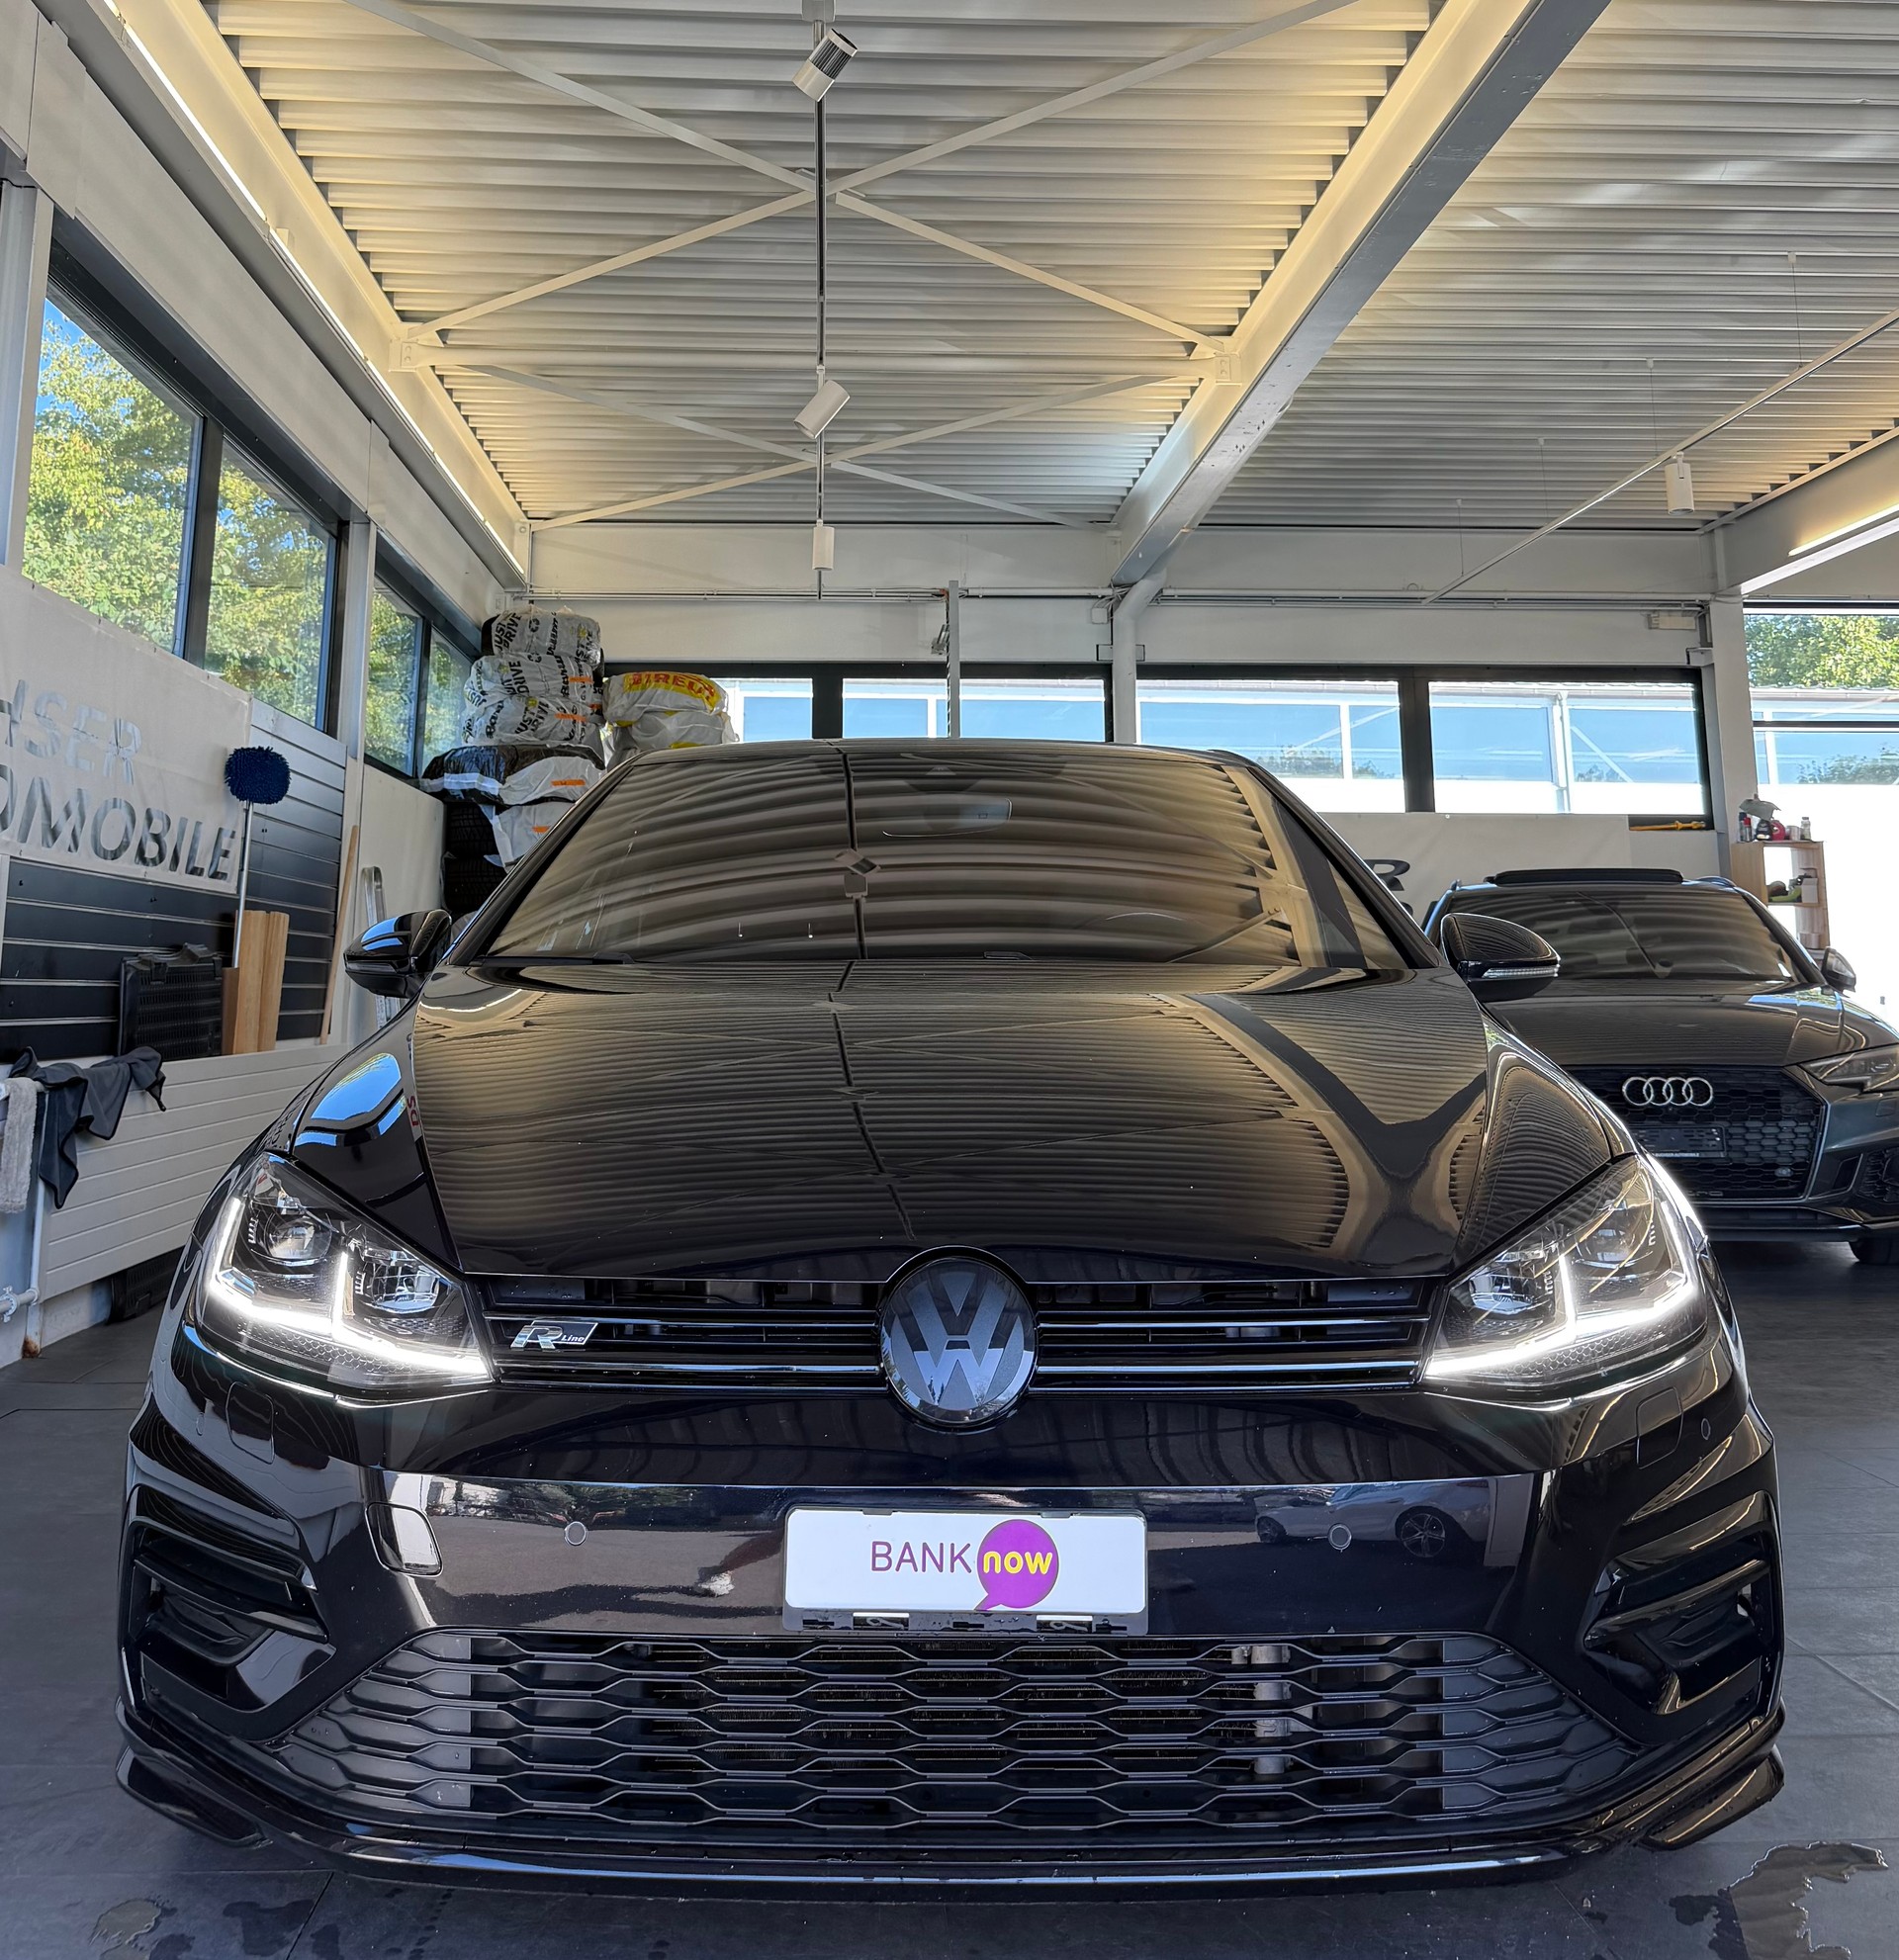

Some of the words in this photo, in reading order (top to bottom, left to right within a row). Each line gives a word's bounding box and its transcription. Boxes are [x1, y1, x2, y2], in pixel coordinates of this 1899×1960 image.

[508, 660, 530, 694] DRIVE
[560, 1334, 586, 1343] Line
[870, 1541, 972, 1574] BANK
[982, 1551, 1053, 1575] now
